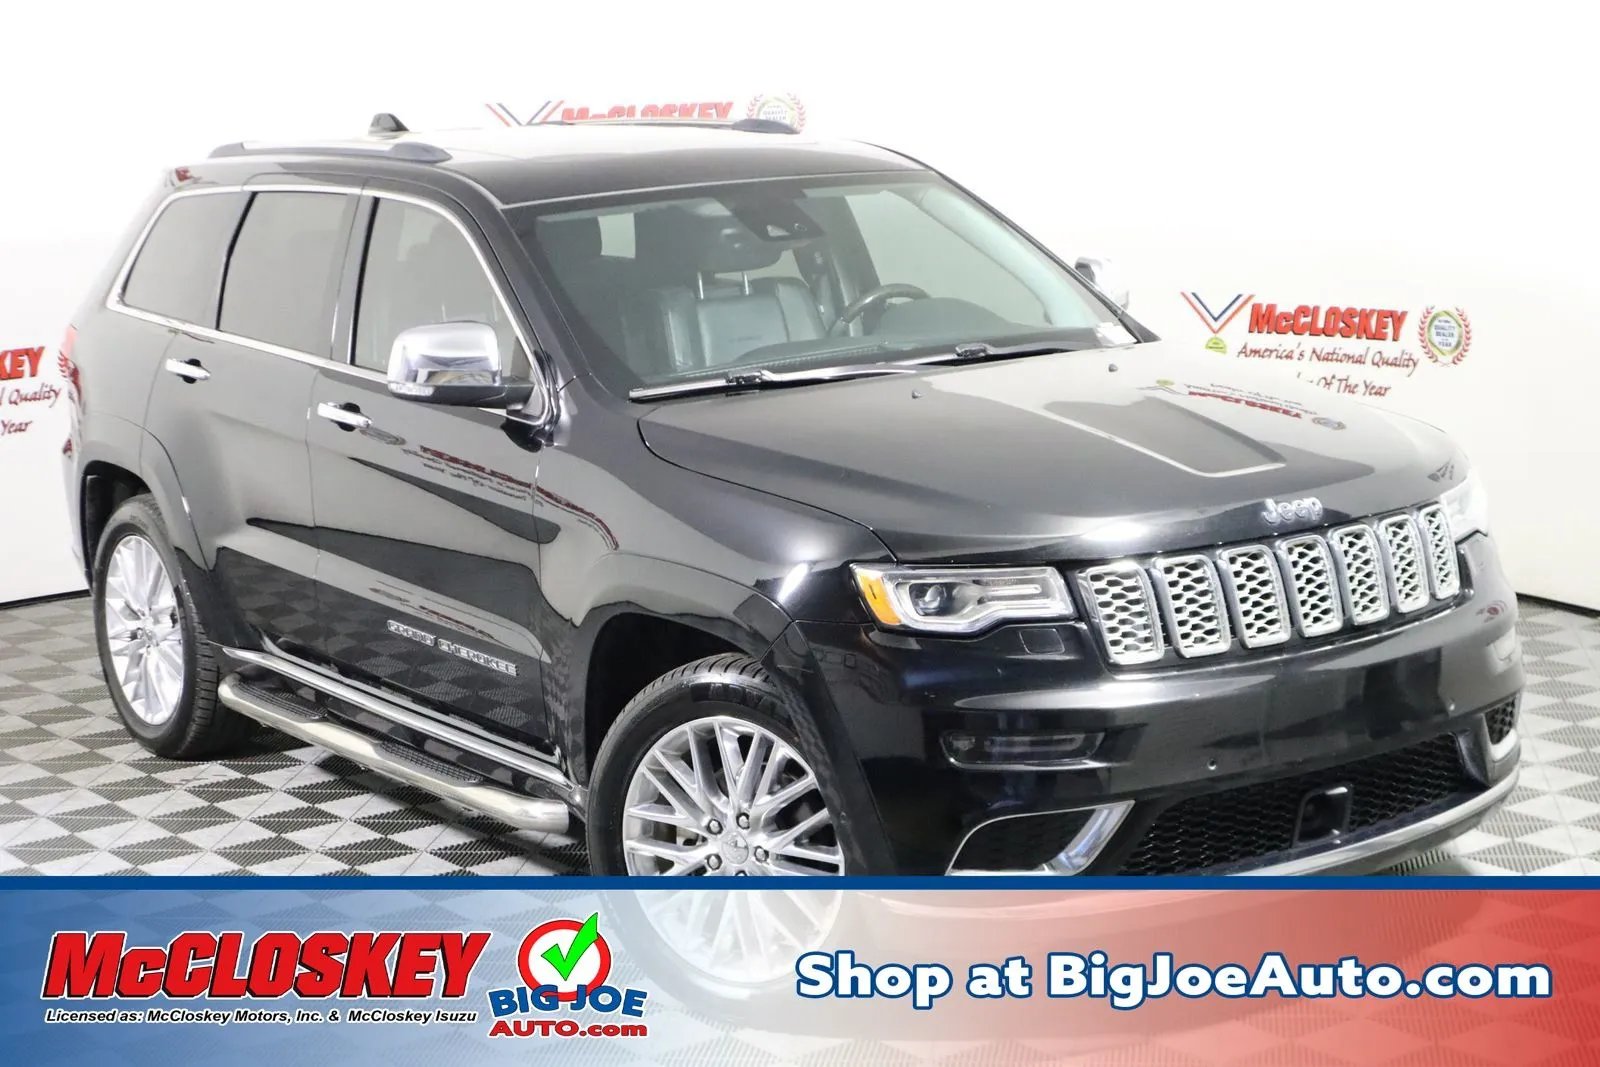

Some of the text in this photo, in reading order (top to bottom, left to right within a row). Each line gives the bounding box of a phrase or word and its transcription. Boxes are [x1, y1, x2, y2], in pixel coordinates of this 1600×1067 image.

[1248, 302, 1408, 342] McCLOSKEY
[1237, 342, 1304, 361] America's
[1309, 347, 1369, 366] National
[1371, 350, 1419, 377] Quality
[8, 382, 62, 409] Quality
[1337, 375, 1358, 394] The
[1362, 379, 1391, 397] Year
[0, 419, 33, 436] Year
[1261, 496, 1323, 525] Jeep
[387, 619, 437, 648] GRAND
[437, 637, 518, 677] CHEROKEE
